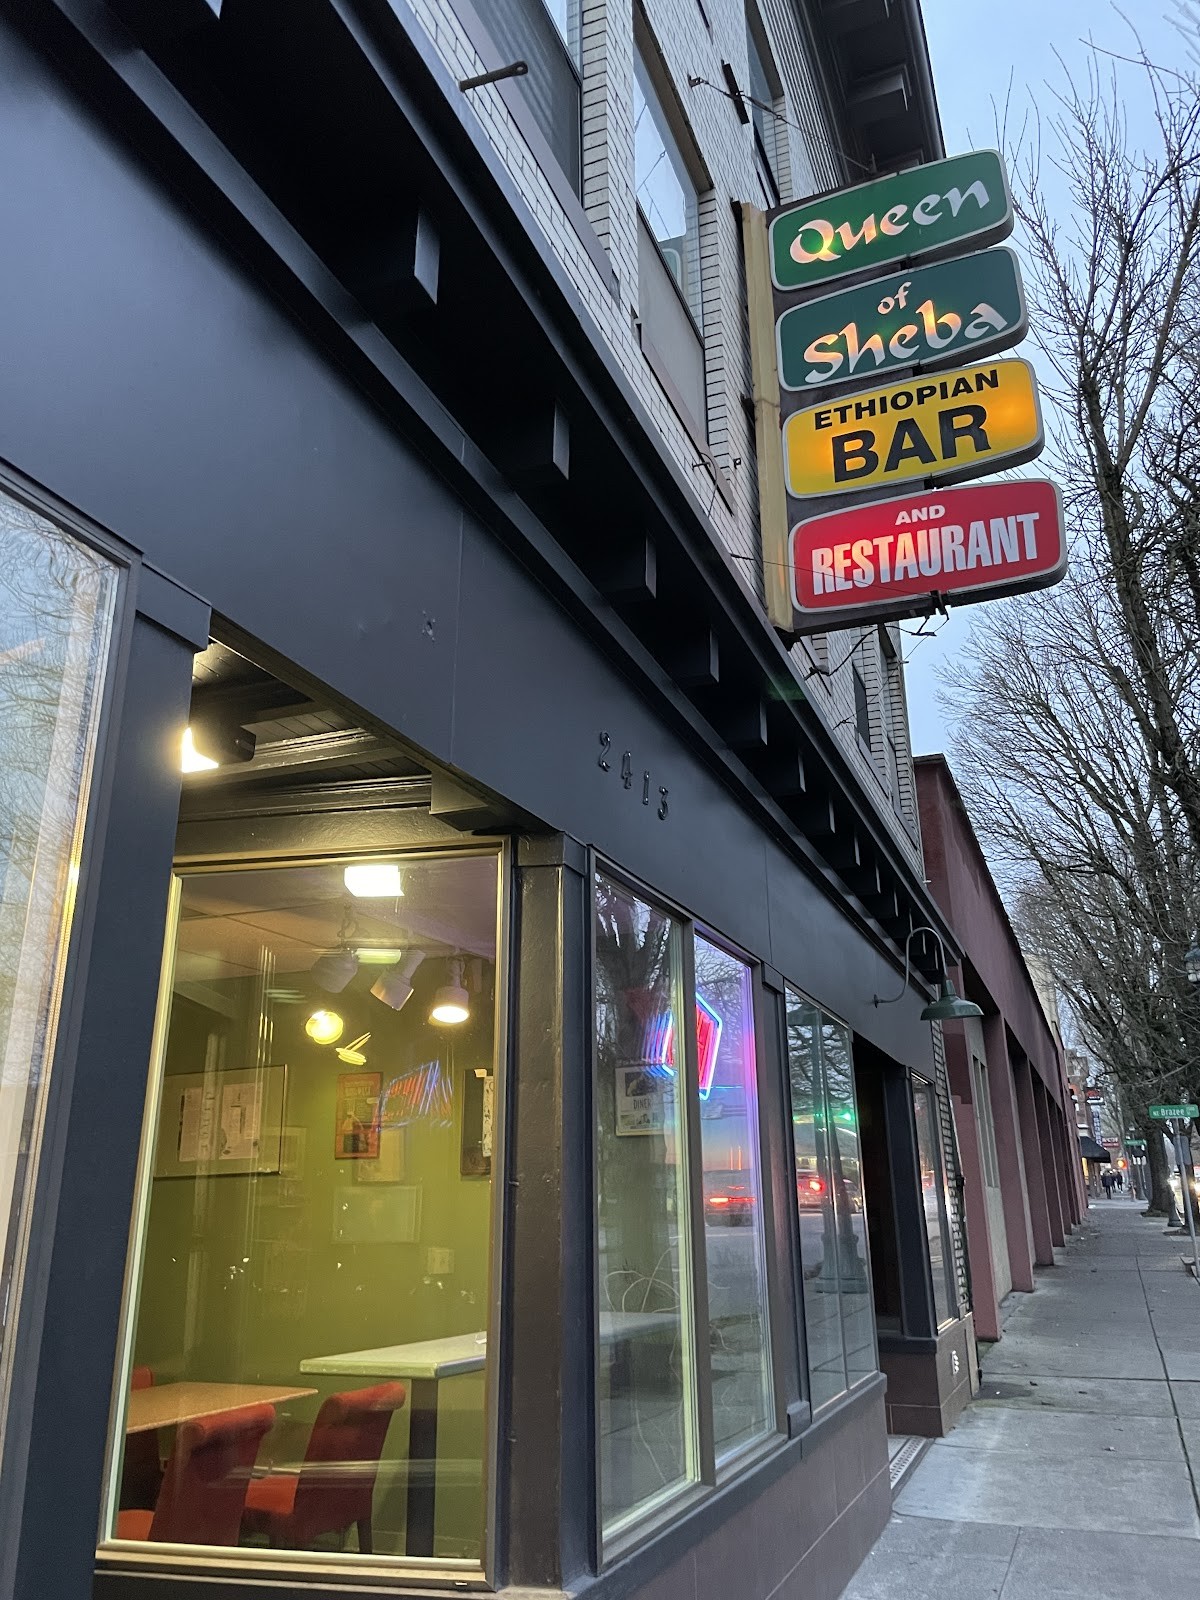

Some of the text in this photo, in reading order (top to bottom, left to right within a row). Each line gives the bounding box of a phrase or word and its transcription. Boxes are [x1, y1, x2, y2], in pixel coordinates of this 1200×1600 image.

[790, 179, 990, 264] Queen
[877, 281, 912, 315] of
[803, 300, 1008, 384] Sheba
[814, 369, 999, 431] ETHIOPIAN
[831, 403, 991, 484] BAR
[811, 512, 1040, 596] RESTAURANT
[895, 504, 946, 526] AND
[598, 731, 669, 821] 2413
[1160, 1107, 1185, 1117] Brazee
